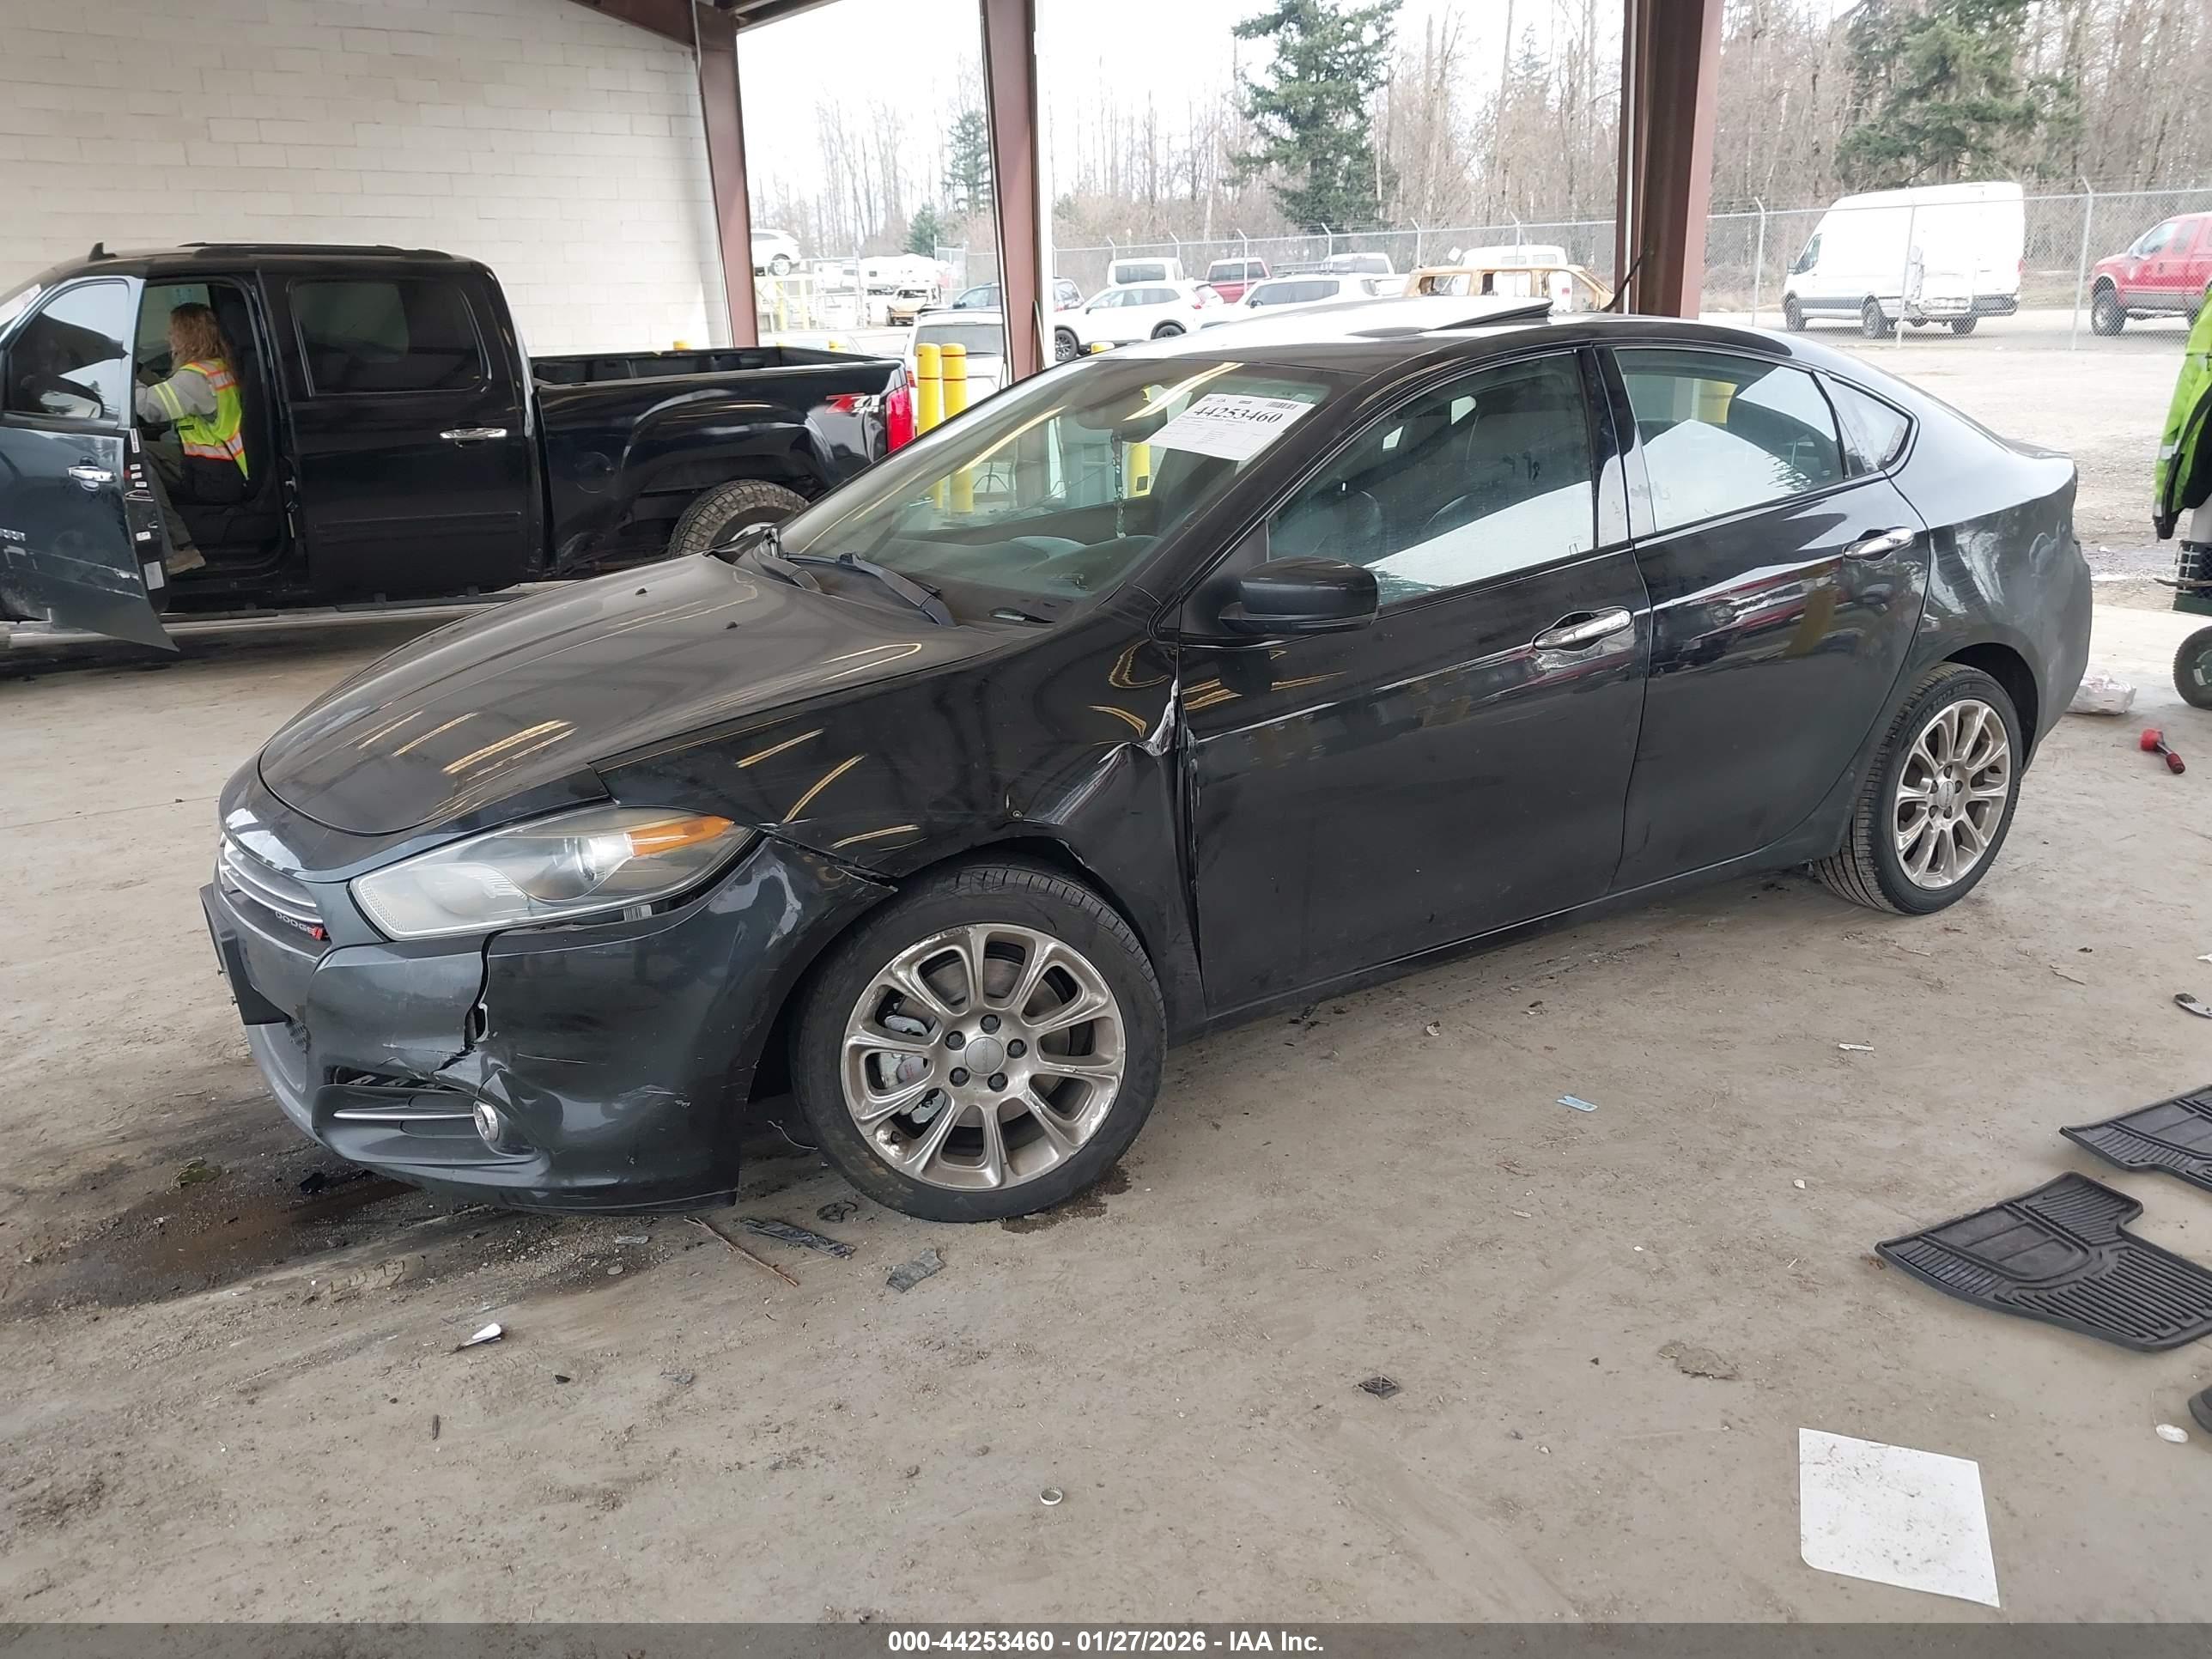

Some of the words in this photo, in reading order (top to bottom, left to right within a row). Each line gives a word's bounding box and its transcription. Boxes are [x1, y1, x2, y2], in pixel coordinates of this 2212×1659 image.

[825, 392, 881, 414] Z71
[1194, 405, 1284, 424] 44253460
[276, 911, 315, 936] DODGE
